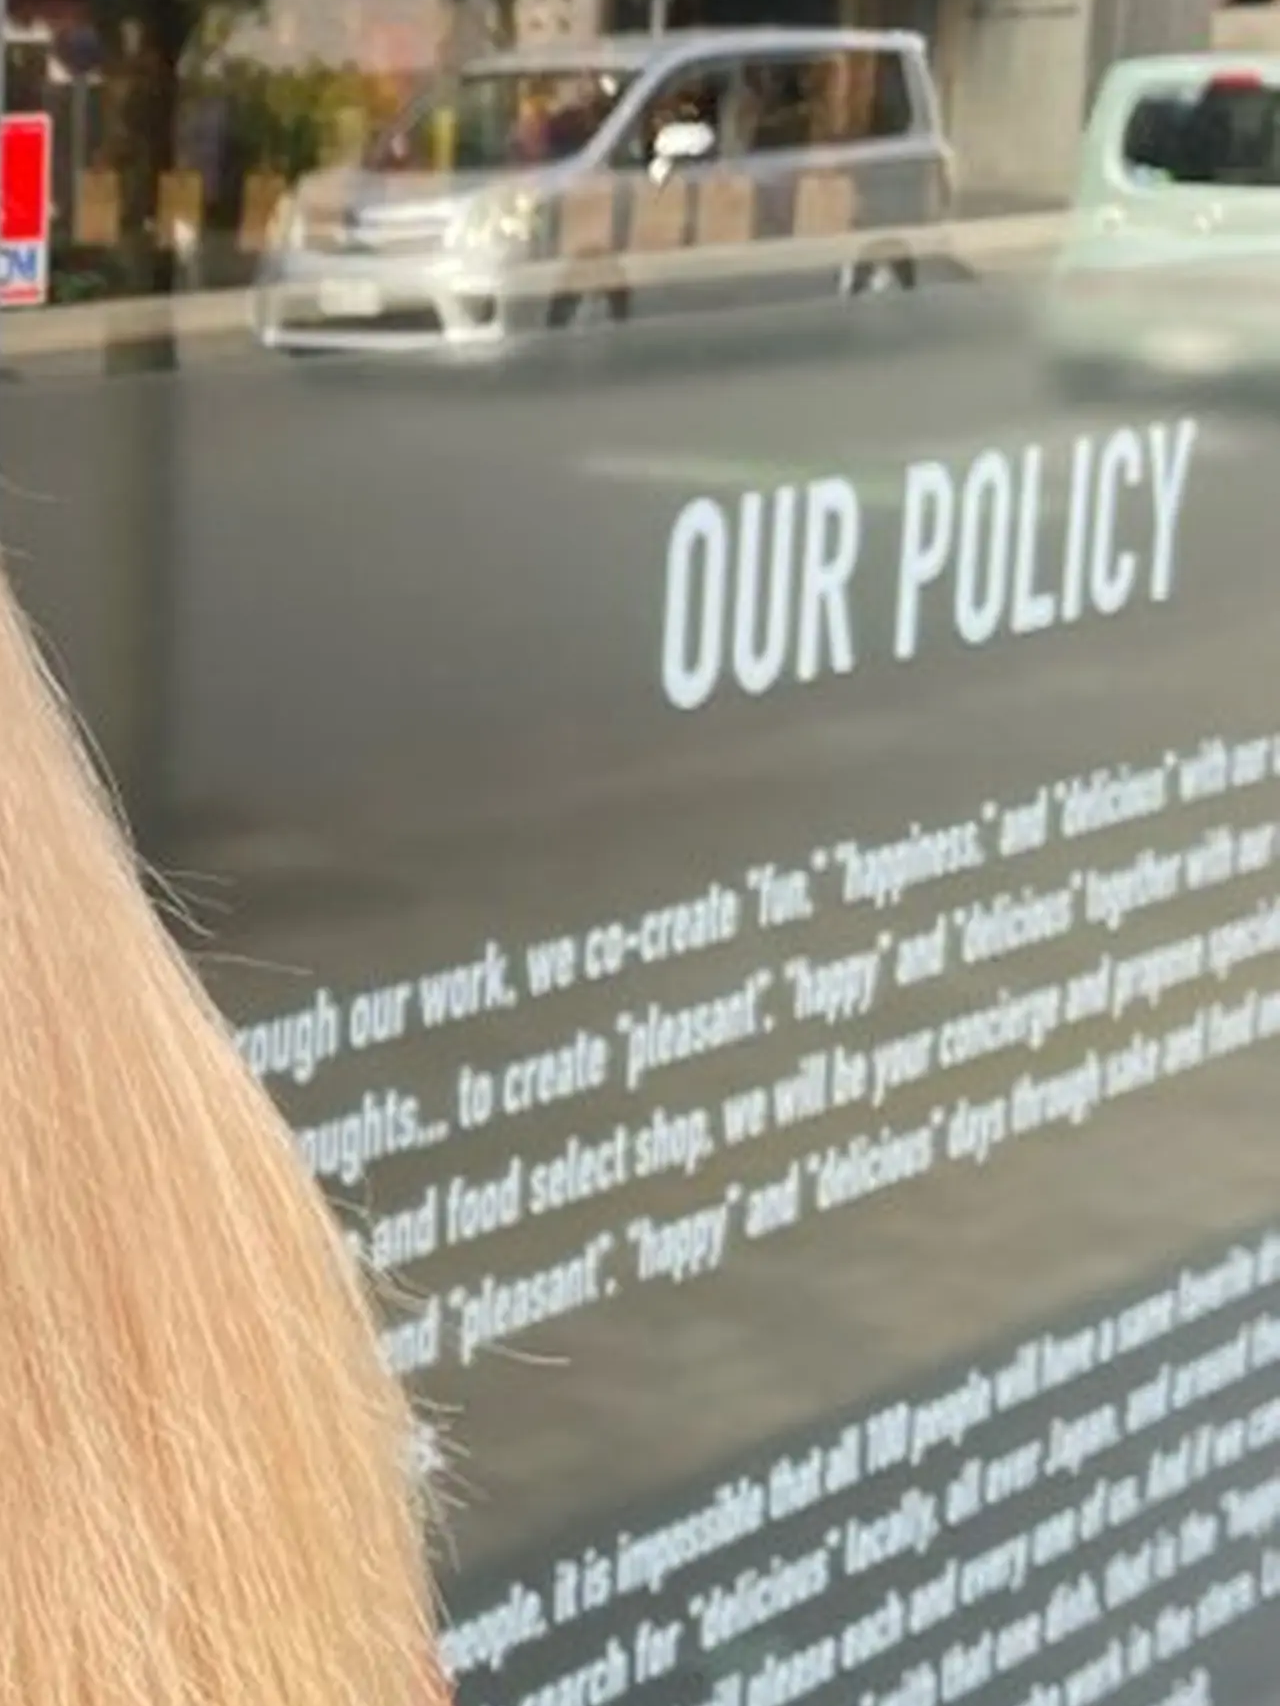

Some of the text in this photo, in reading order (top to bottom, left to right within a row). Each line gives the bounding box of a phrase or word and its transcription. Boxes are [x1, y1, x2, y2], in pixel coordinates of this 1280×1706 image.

[662, 418, 1198, 709] OUR POLICY
[348, 981, 411, 1048] our
[525, 935, 576, 996] we
[584, 883, 740, 979] co-create
[998, 785, 1048, 856] and
[458, 1064, 493, 1128] to
[502, 1029, 608, 1114] create
[894, 913, 946, 985] and
[371, 1185, 438, 1274] and
[445, 1156, 522, 1243] food
[528, 1124, 627, 1214] select
[722, 1087, 768, 1143] we
[772, 1051, 828, 1125] will
[830, 1045, 868, 1105] be
[625, 1182, 742, 1282] "happy"
[744, 1160, 800, 1237] and
[553, 1561, 578, 1623] it
[581, 1547, 612, 1610] is
[633, 1620, 682, 1683] for
